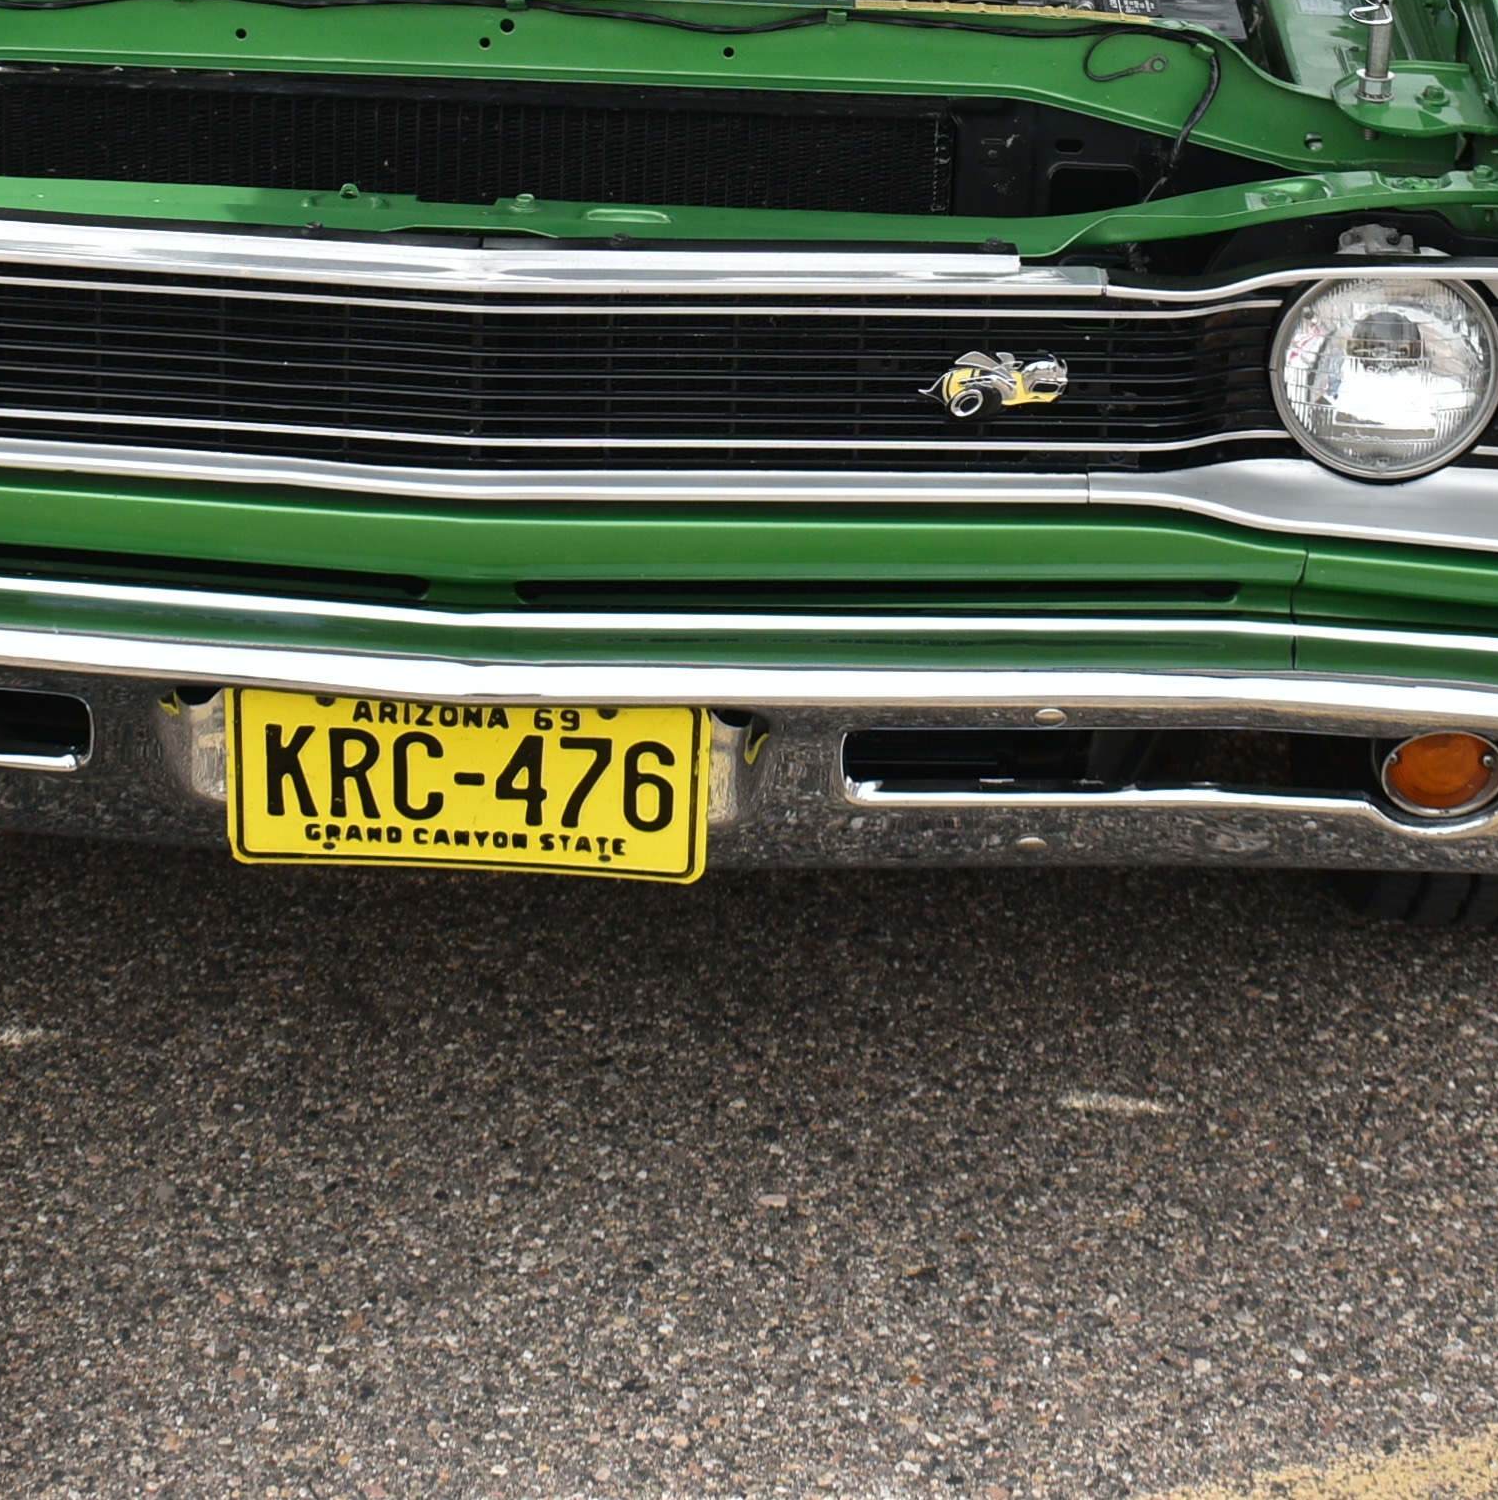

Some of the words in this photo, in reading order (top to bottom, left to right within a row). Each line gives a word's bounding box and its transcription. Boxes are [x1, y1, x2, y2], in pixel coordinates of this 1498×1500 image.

[352, 700, 510, 730] ARIZONA
[533, 707, 582, 732] 69
[264, 722, 677, 833] KRC-476
[304, 822, 402, 845] GRAND
[413, 827, 529, 851] CANYON
[540, 833, 627, 857] STATE
